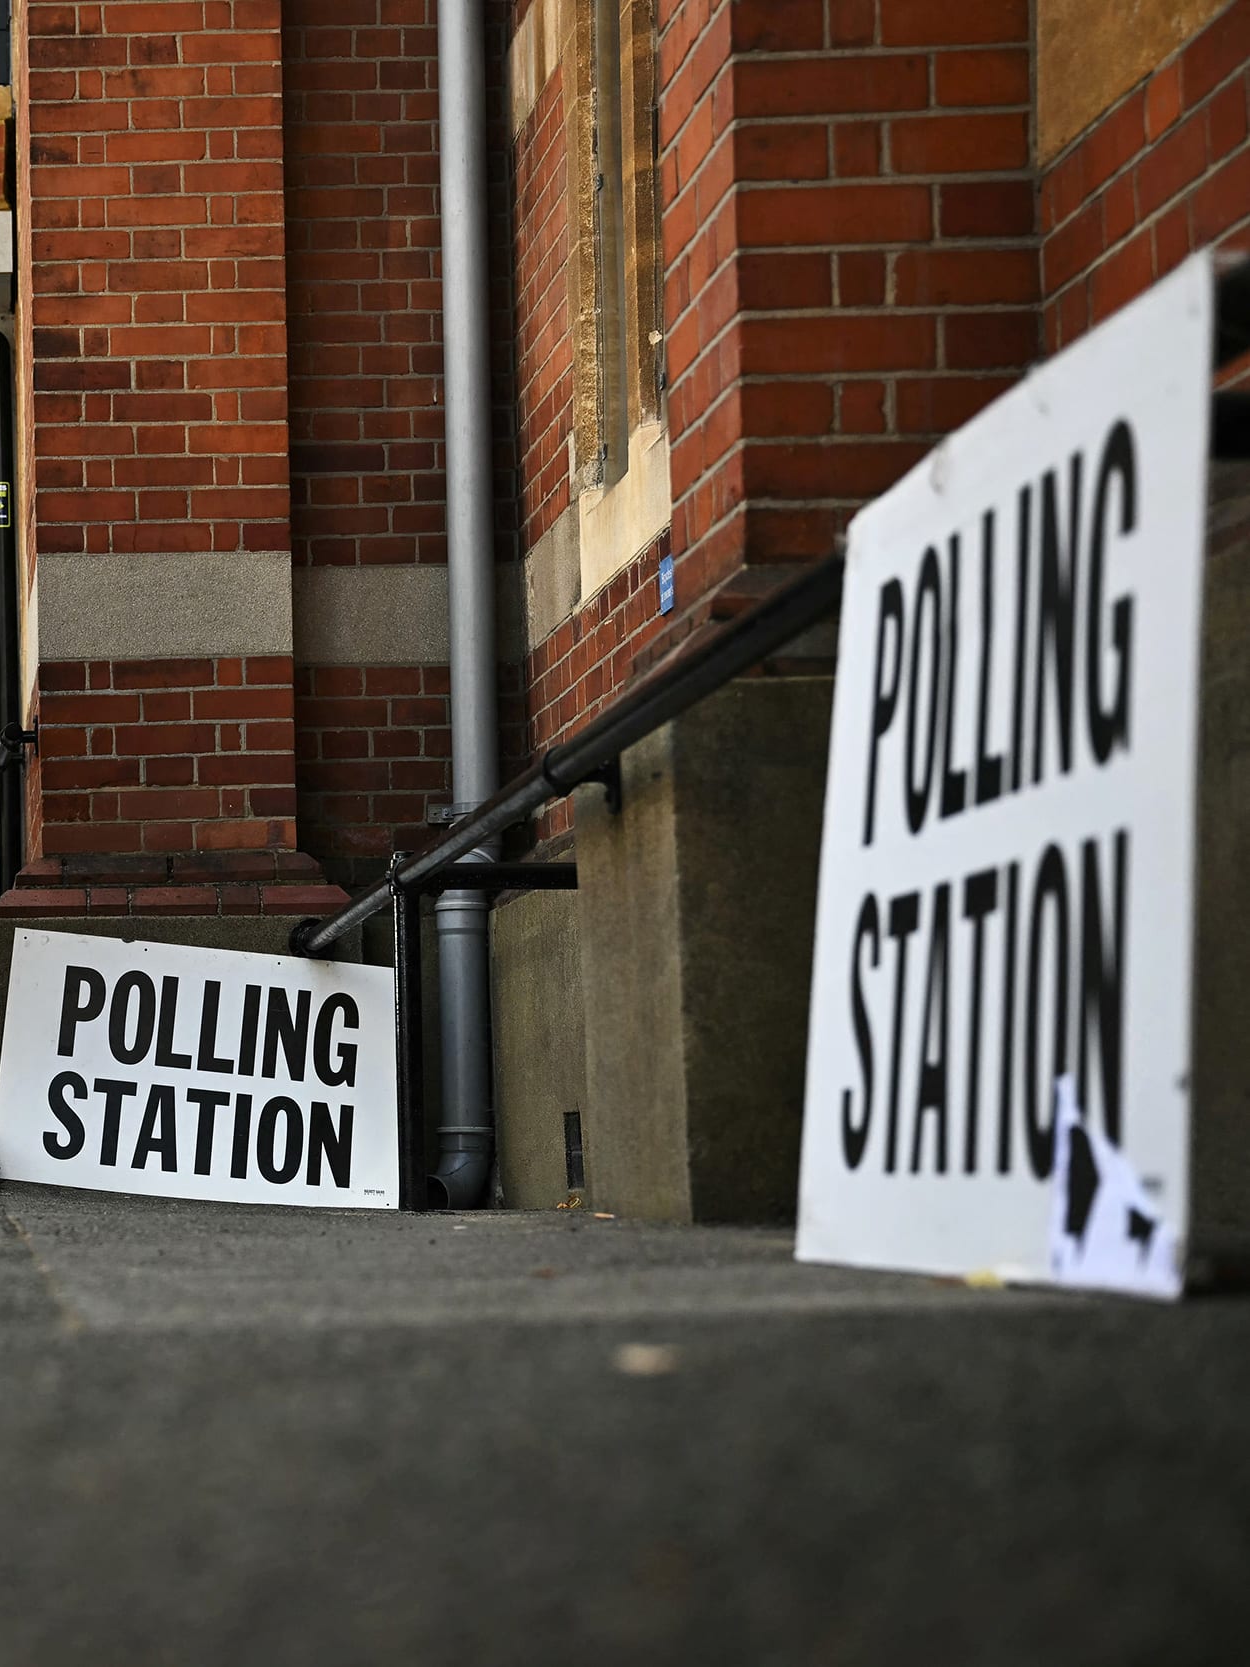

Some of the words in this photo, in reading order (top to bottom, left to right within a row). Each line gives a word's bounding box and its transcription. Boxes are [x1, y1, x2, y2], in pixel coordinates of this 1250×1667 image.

[862, 418, 1138, 847] POLLING
[56, 964, 360, 1088] POLLING
[842, 831, 1128, 1182] STATION
[42, 1070, 354, 1189] STATION
